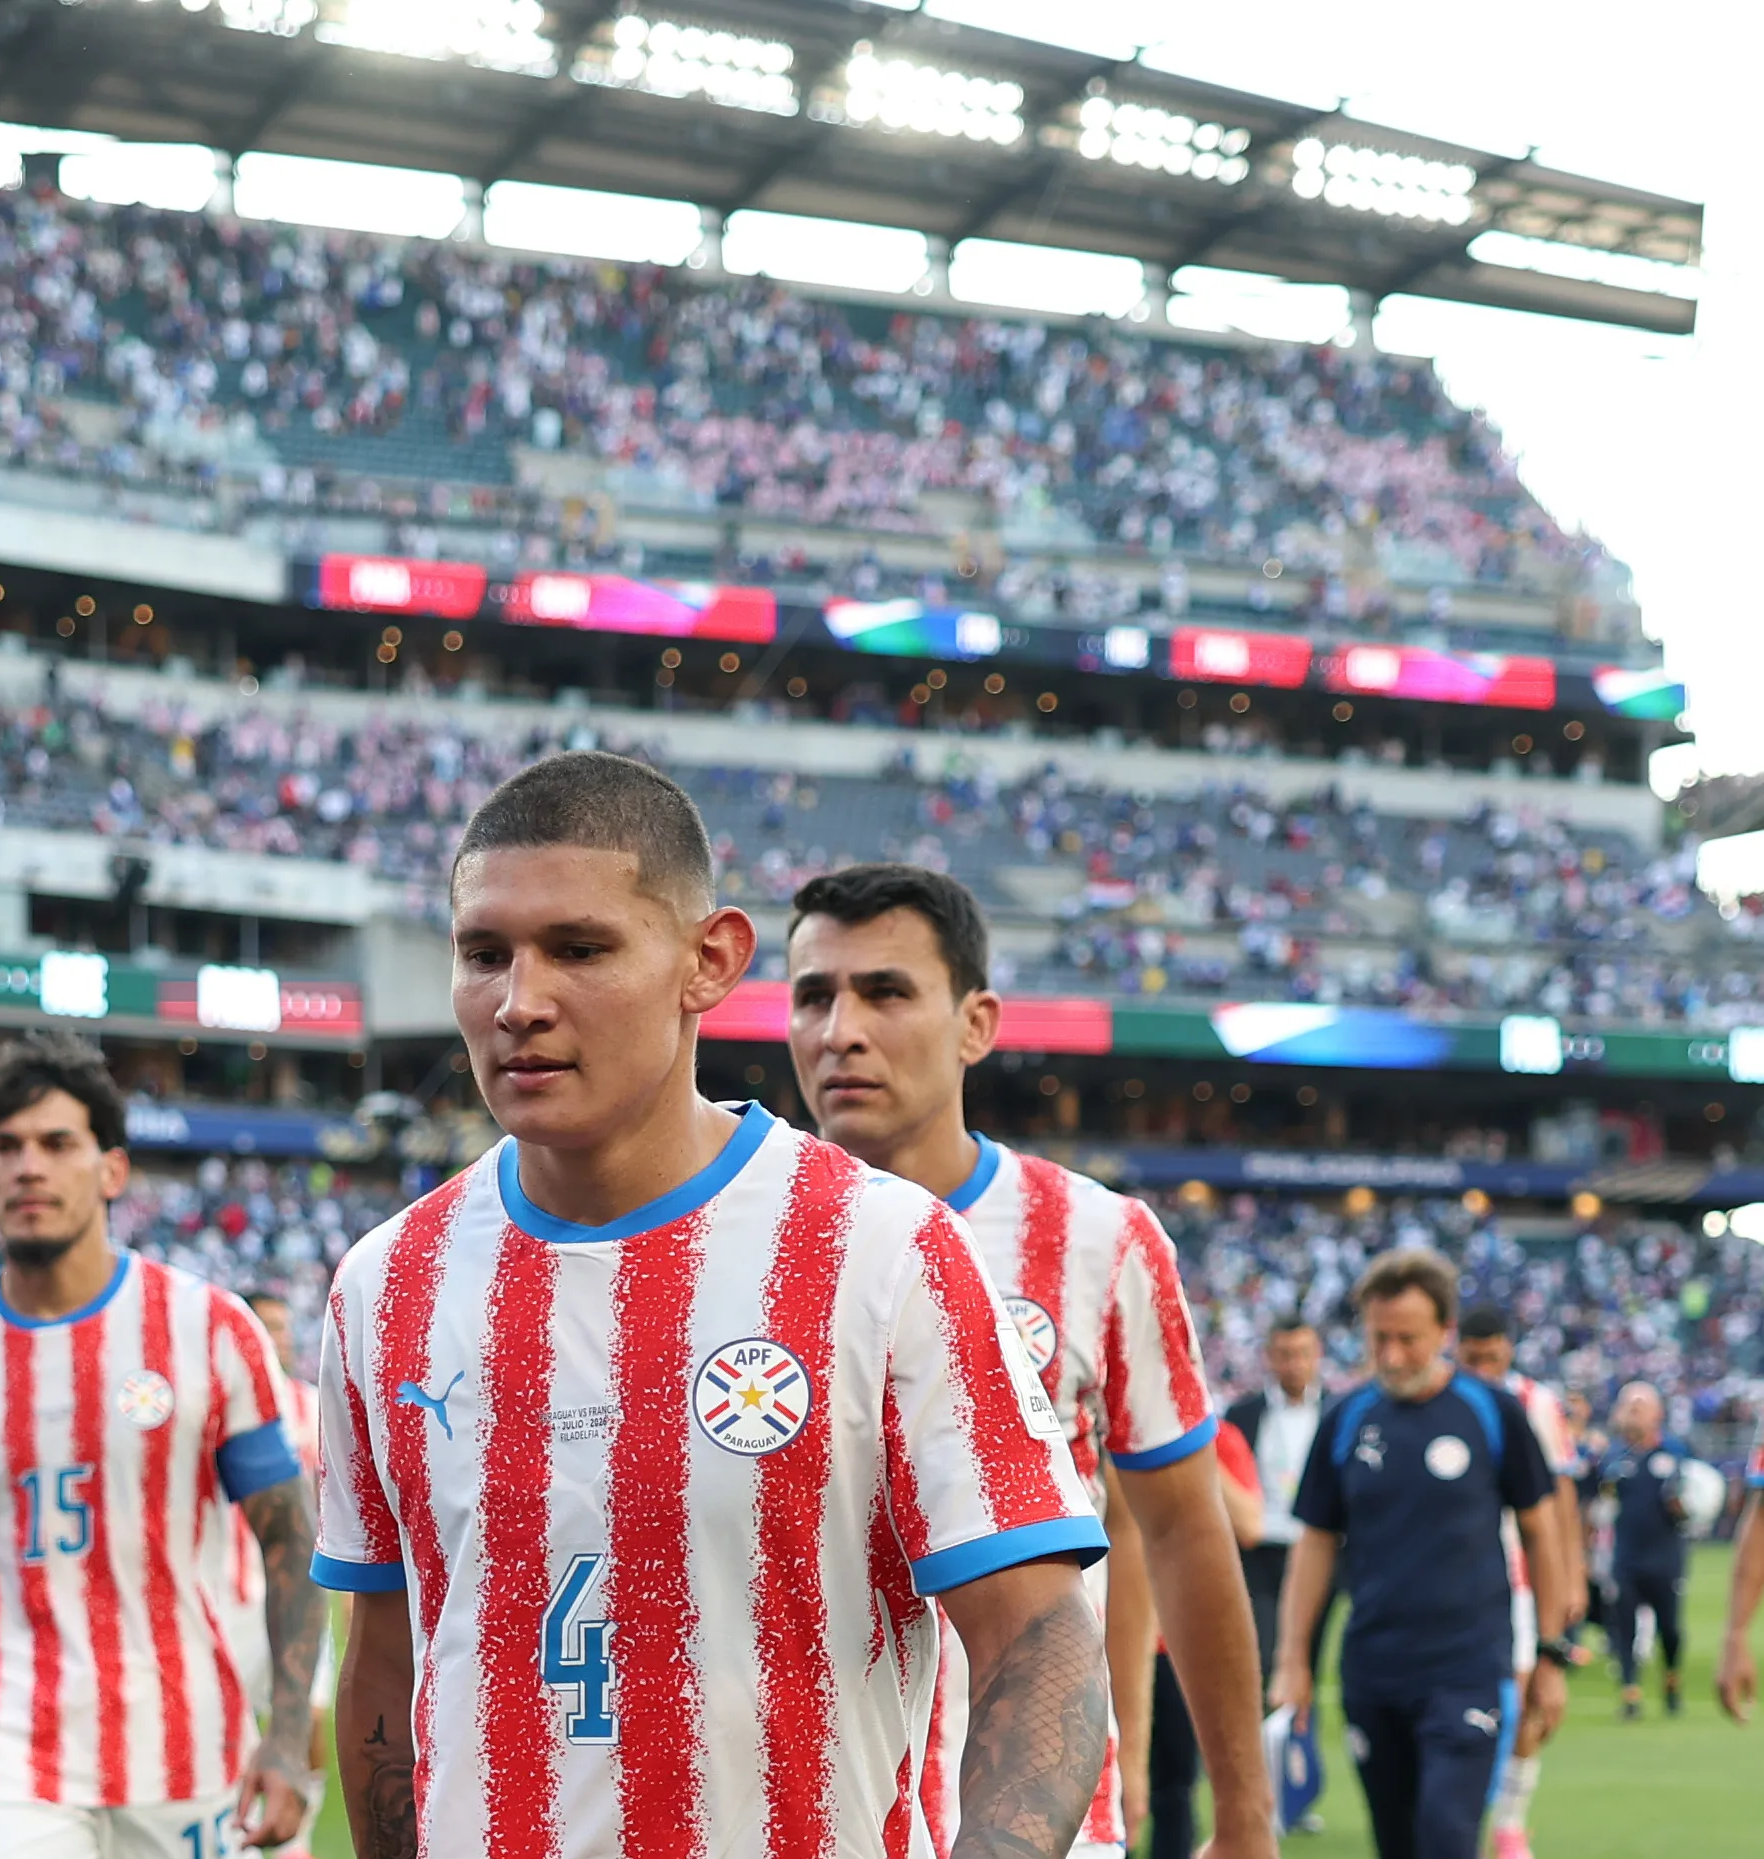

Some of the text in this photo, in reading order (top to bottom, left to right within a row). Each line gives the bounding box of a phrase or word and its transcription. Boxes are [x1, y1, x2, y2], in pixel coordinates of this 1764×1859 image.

[733, 1347, 773, 1366] APF
[578, 1406, 588, 1418] VS
[562, 1419, 584, 1431] JULIO
[590, 1416, 608, 1428] 2026
[560, 1429, 600, 1442] FILADELFIA
[723, 1433, 778, 1449] PARAGUAY
[19, 1467, 92, 1560] 15
[538, 1553, 620, 1746] 4
